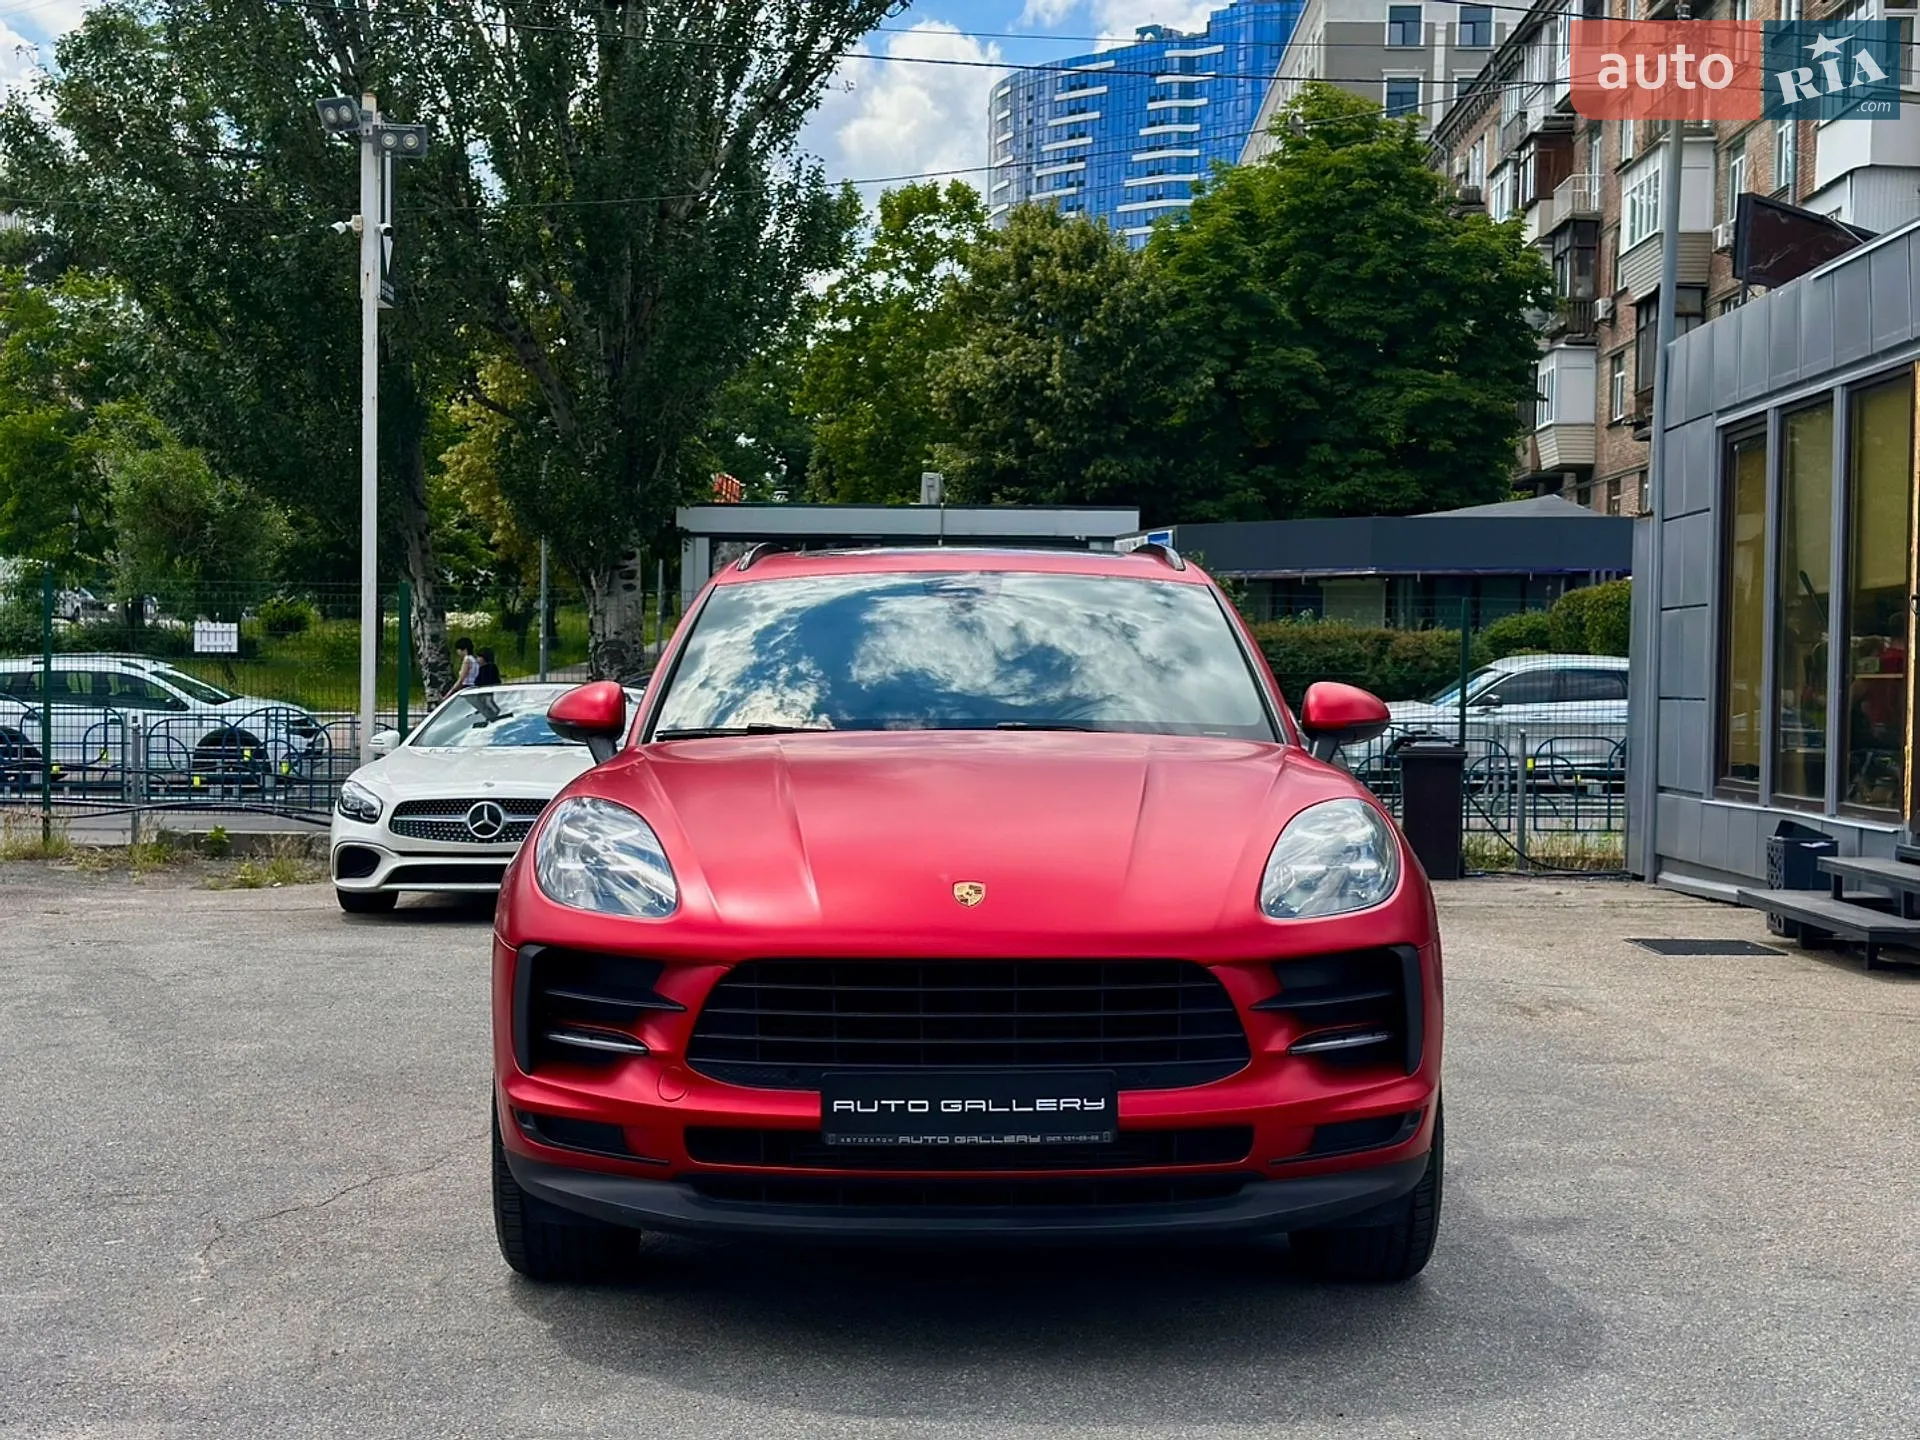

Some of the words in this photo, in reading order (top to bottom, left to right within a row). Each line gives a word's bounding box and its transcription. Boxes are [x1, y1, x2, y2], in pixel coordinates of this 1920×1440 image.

[833, 1099, 930, 1113] AUTO
[940, 1097, 1105, 1113] GALLERY
[898, 1135, 950, 1144] AUTO
[954, 1134, 1041, 1145] GALLERY
